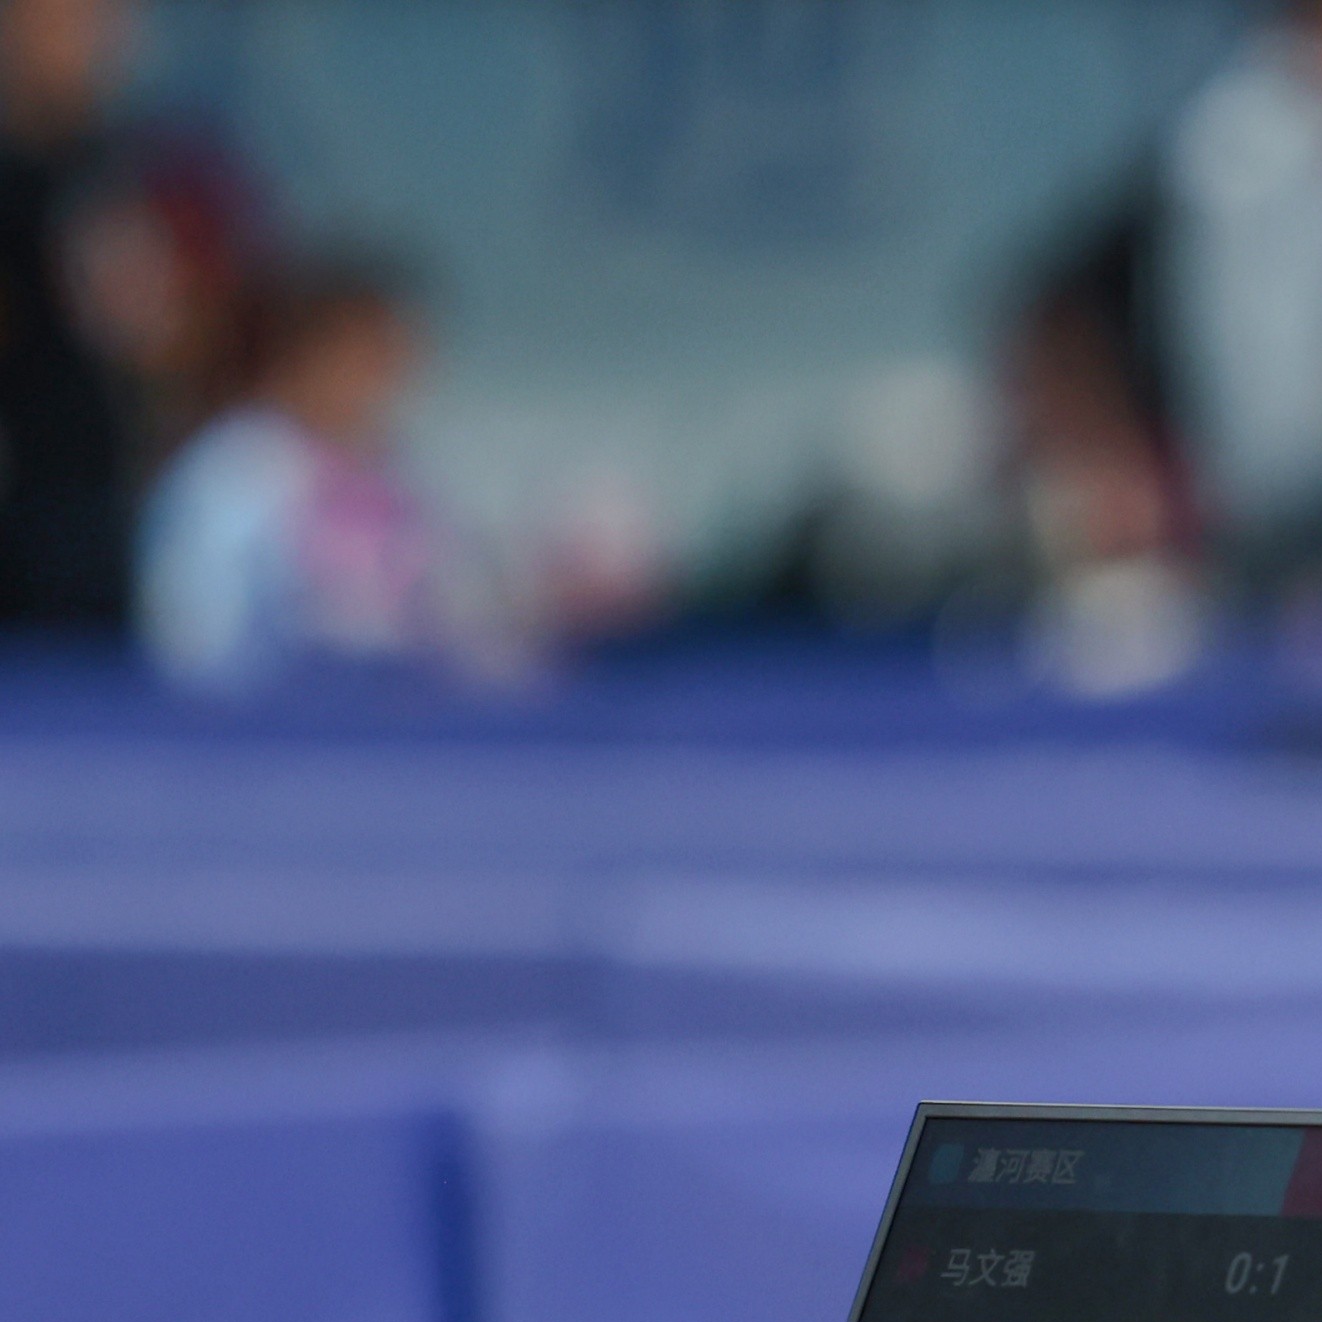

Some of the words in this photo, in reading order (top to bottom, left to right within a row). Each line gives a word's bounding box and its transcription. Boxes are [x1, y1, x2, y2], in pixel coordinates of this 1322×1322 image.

[940, 1247, 1036, 1288] 马文强
[1224, 1250, 1291, 1296] 0:1
